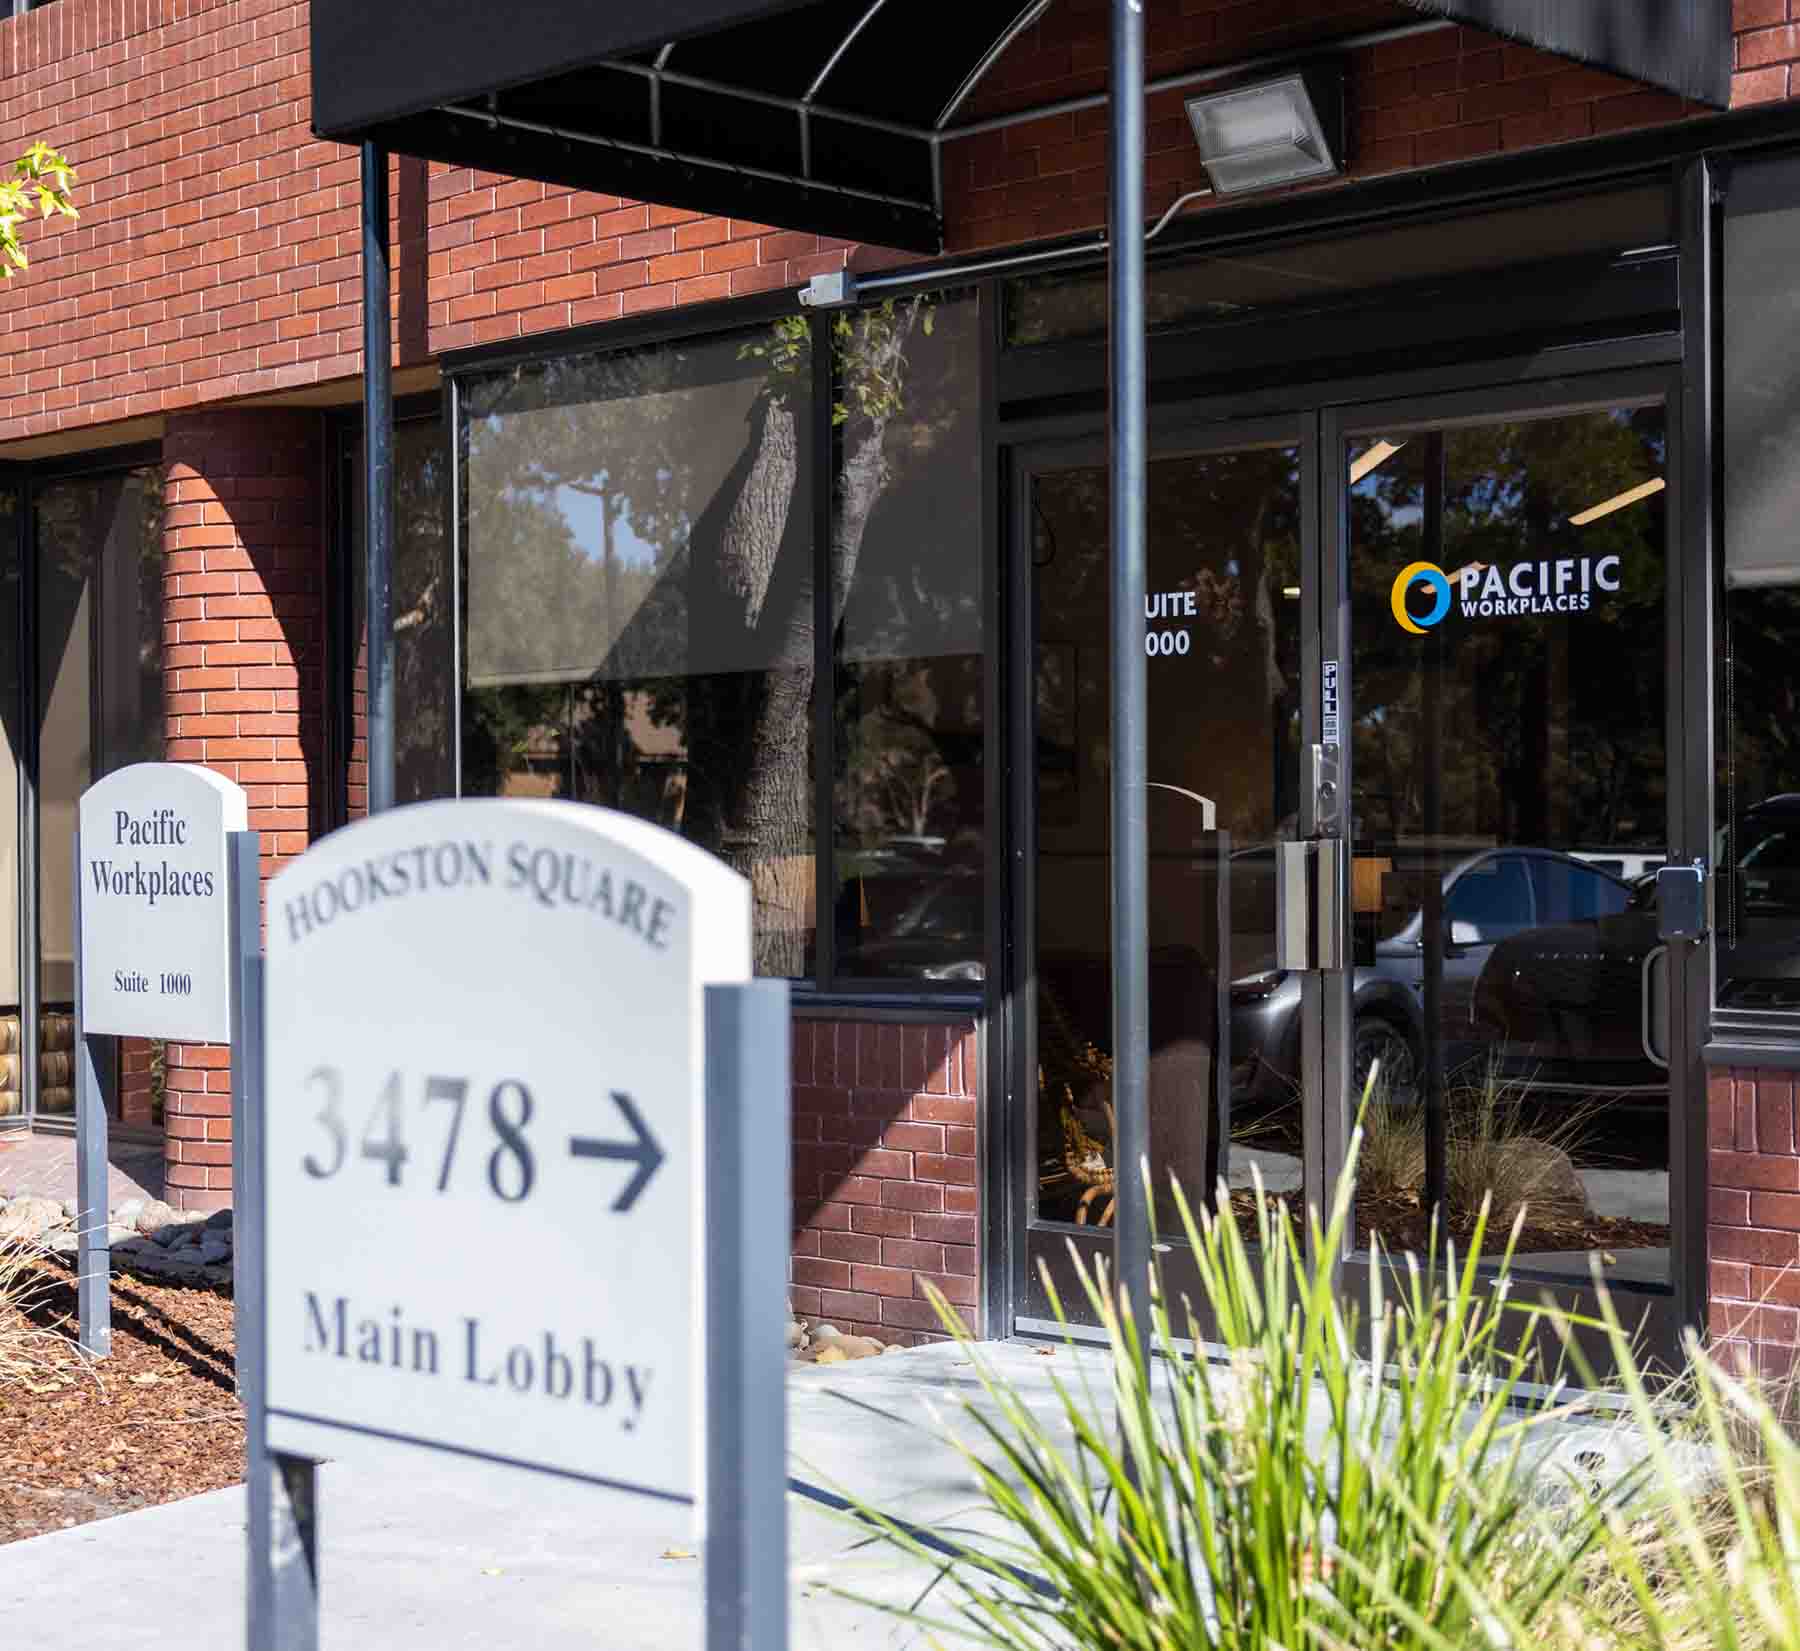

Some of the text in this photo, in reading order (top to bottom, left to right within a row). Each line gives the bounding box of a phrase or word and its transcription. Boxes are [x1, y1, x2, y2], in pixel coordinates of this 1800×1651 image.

[1460, 555, 1620, 601] PACIFIC
[1144, 592, 1197, 618] UITE
[1461, 593, 1590, 617] WORKPLACES
[1144, 630, 1190, 656] 000
[1324, 664, 1337, 714] PULL
[115, 810, 186, 846] Pacific
[90, 860, 214, 905] Workplaces
[282, 839, 677, 949] HOOKSTON SQUARE
[114, 969, 192, 995] Suite 1000
[302, 1064, 536, 1203] 3478
[305, 1290, 652, 1432] Main Lobby
